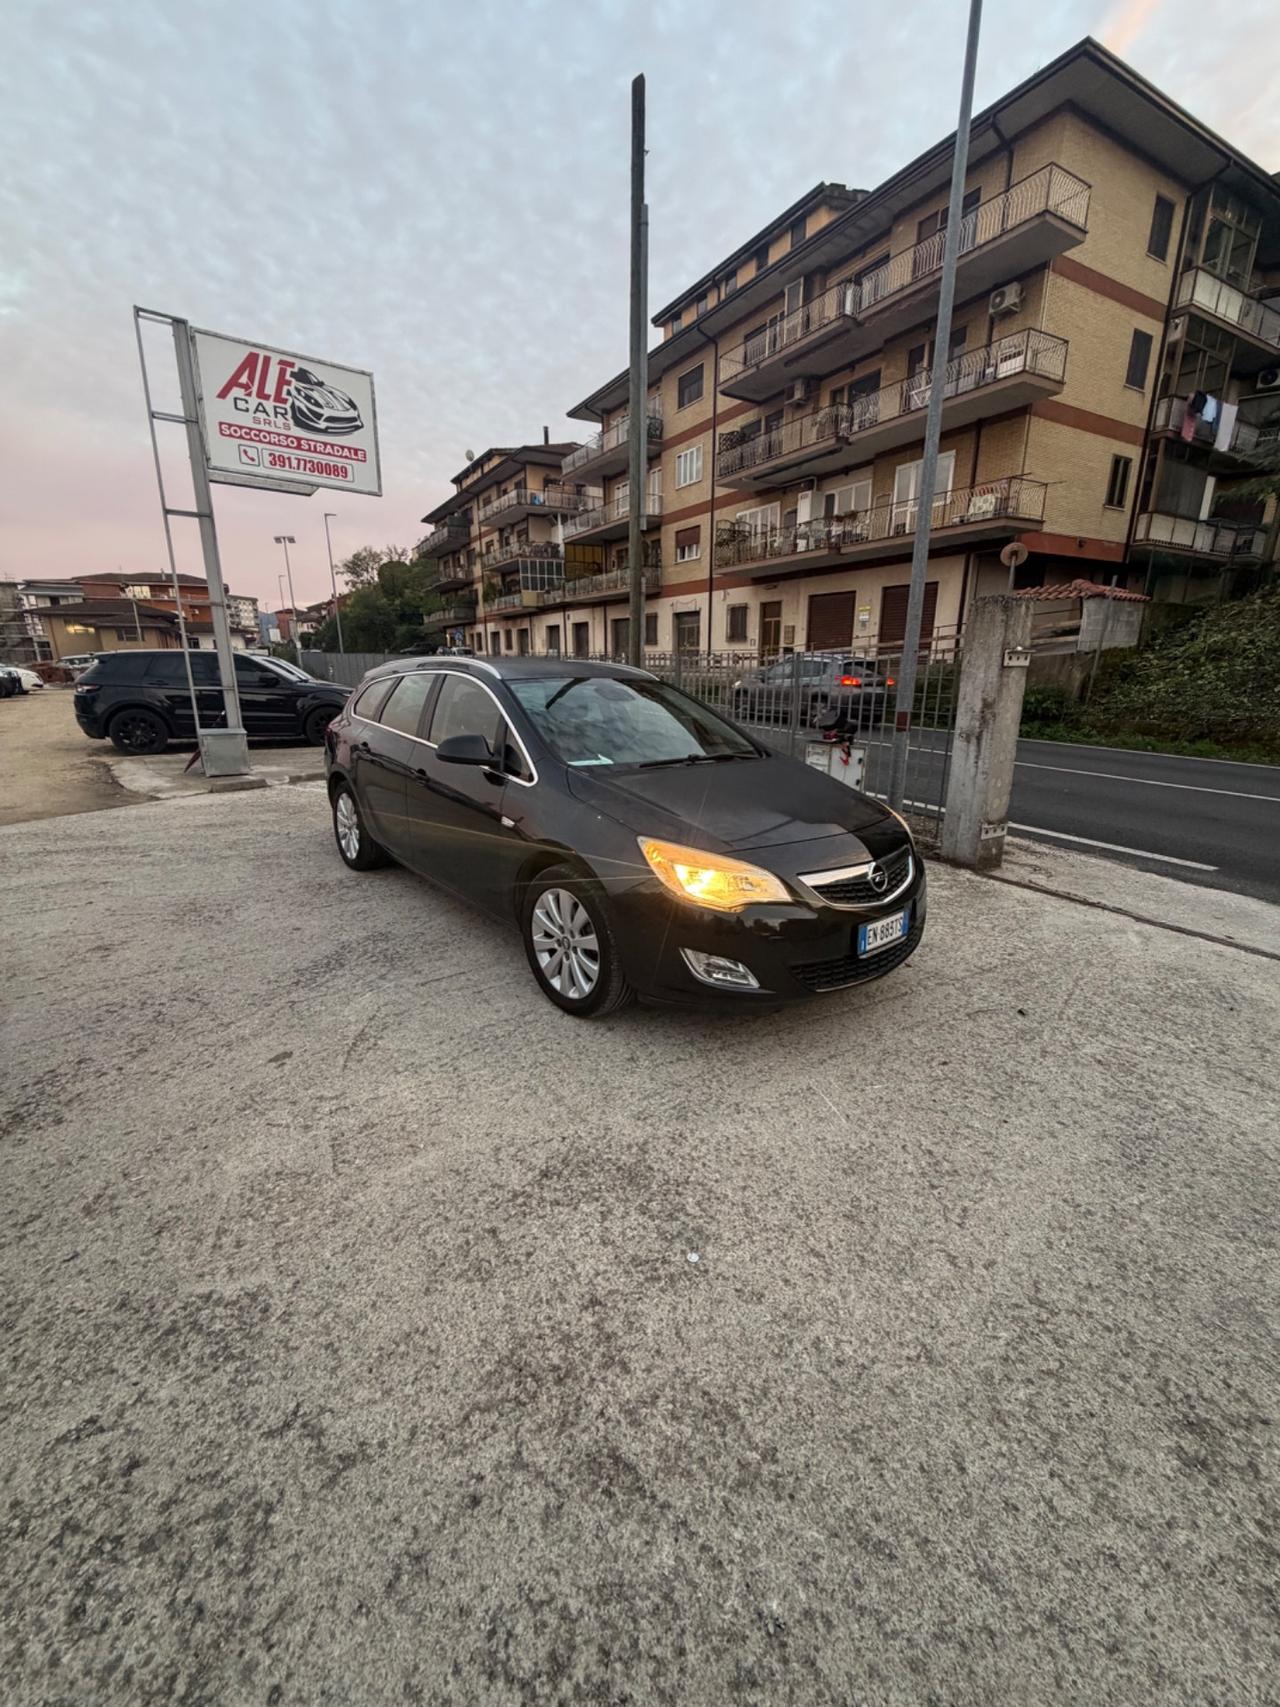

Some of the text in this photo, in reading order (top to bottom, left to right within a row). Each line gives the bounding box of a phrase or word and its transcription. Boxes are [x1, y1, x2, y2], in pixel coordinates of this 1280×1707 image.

[216, 351, 295, 405] ALE
[233, 397, 290, 421] CAR
[252, 416, 291, 431] SRLS
[220, 424, 367, 462] SOCCORSO STRADALE
[268, 452, 348, 479] 391.7730089
